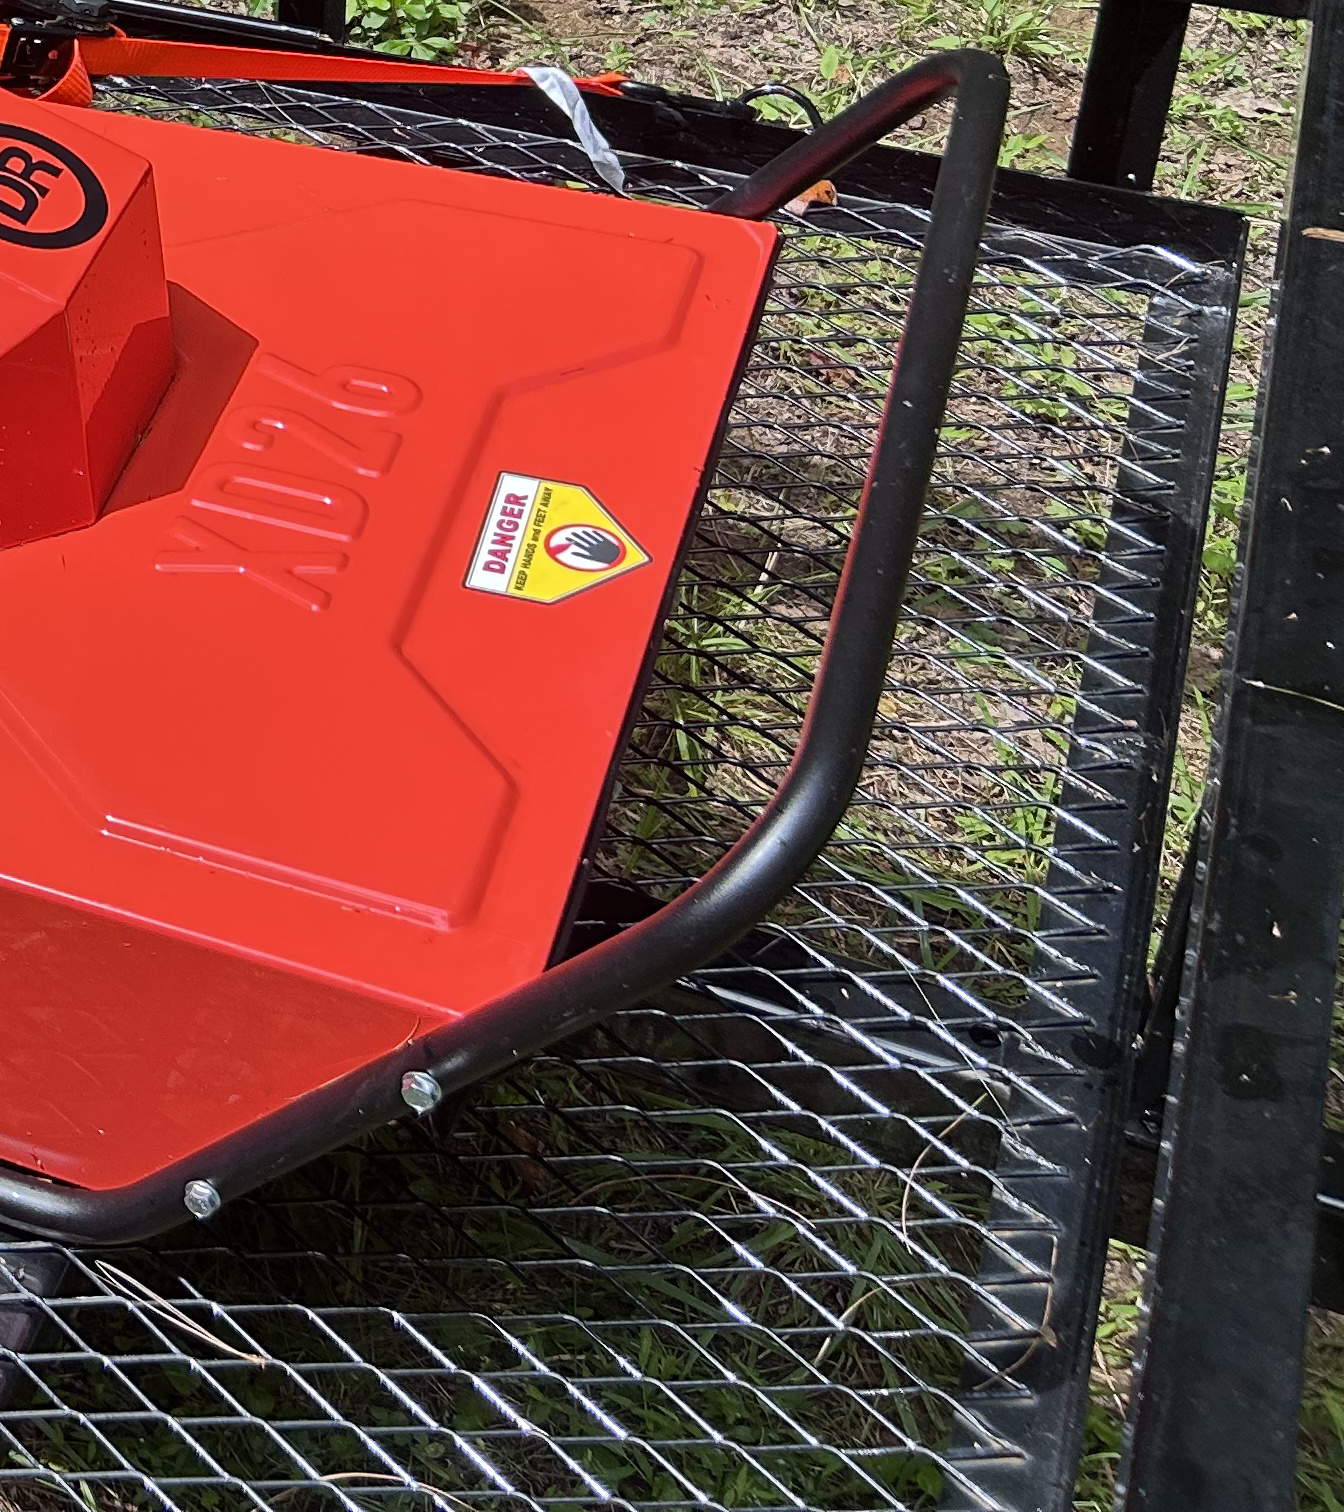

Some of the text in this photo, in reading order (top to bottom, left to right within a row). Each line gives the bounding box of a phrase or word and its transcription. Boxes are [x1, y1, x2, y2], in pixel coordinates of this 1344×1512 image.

[154, 352, 423, 611] XD26
[482, 492, 529, 575] DANGER
[513, 486, 554, 592] KEEP HANDS and FEET AWAY
